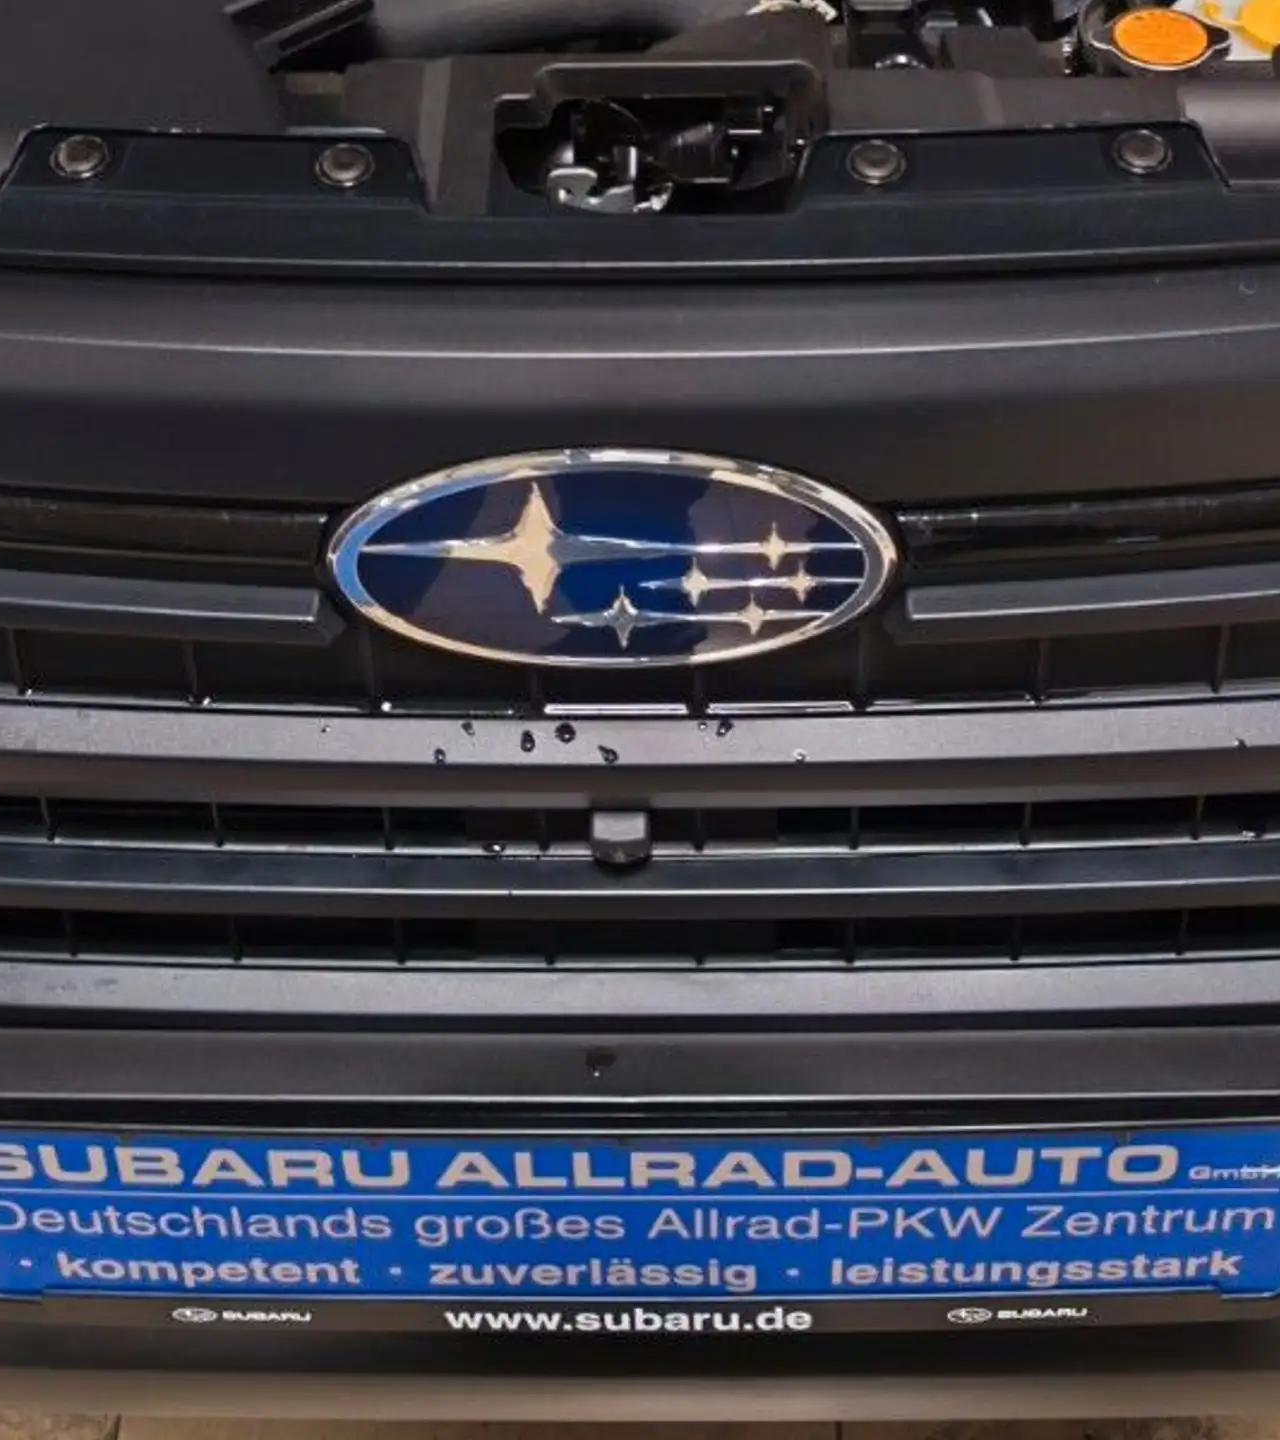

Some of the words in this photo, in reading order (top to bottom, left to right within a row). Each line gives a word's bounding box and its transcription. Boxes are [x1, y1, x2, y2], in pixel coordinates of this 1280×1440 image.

[436, 1144, 1179, 1189] ALLRAD-AUTO
[414, 1207, 626, 1247] großes
[647, 1207, 1003, 1240] Allrad-PKW
[1021, 1204, 1276, 1238] Zentrum
[56, 1250, 361, 1287] kompetent
[428, 1257, 758, 1293] zuverlässig
[832, 1250, 1243, 1287] leistungsstark
[222, 1310, 313, 1323] SUBARU
[442, 1306, 814, 1332] www.subaru.de
[997, 1307, 1089, 1320] SUBARU
